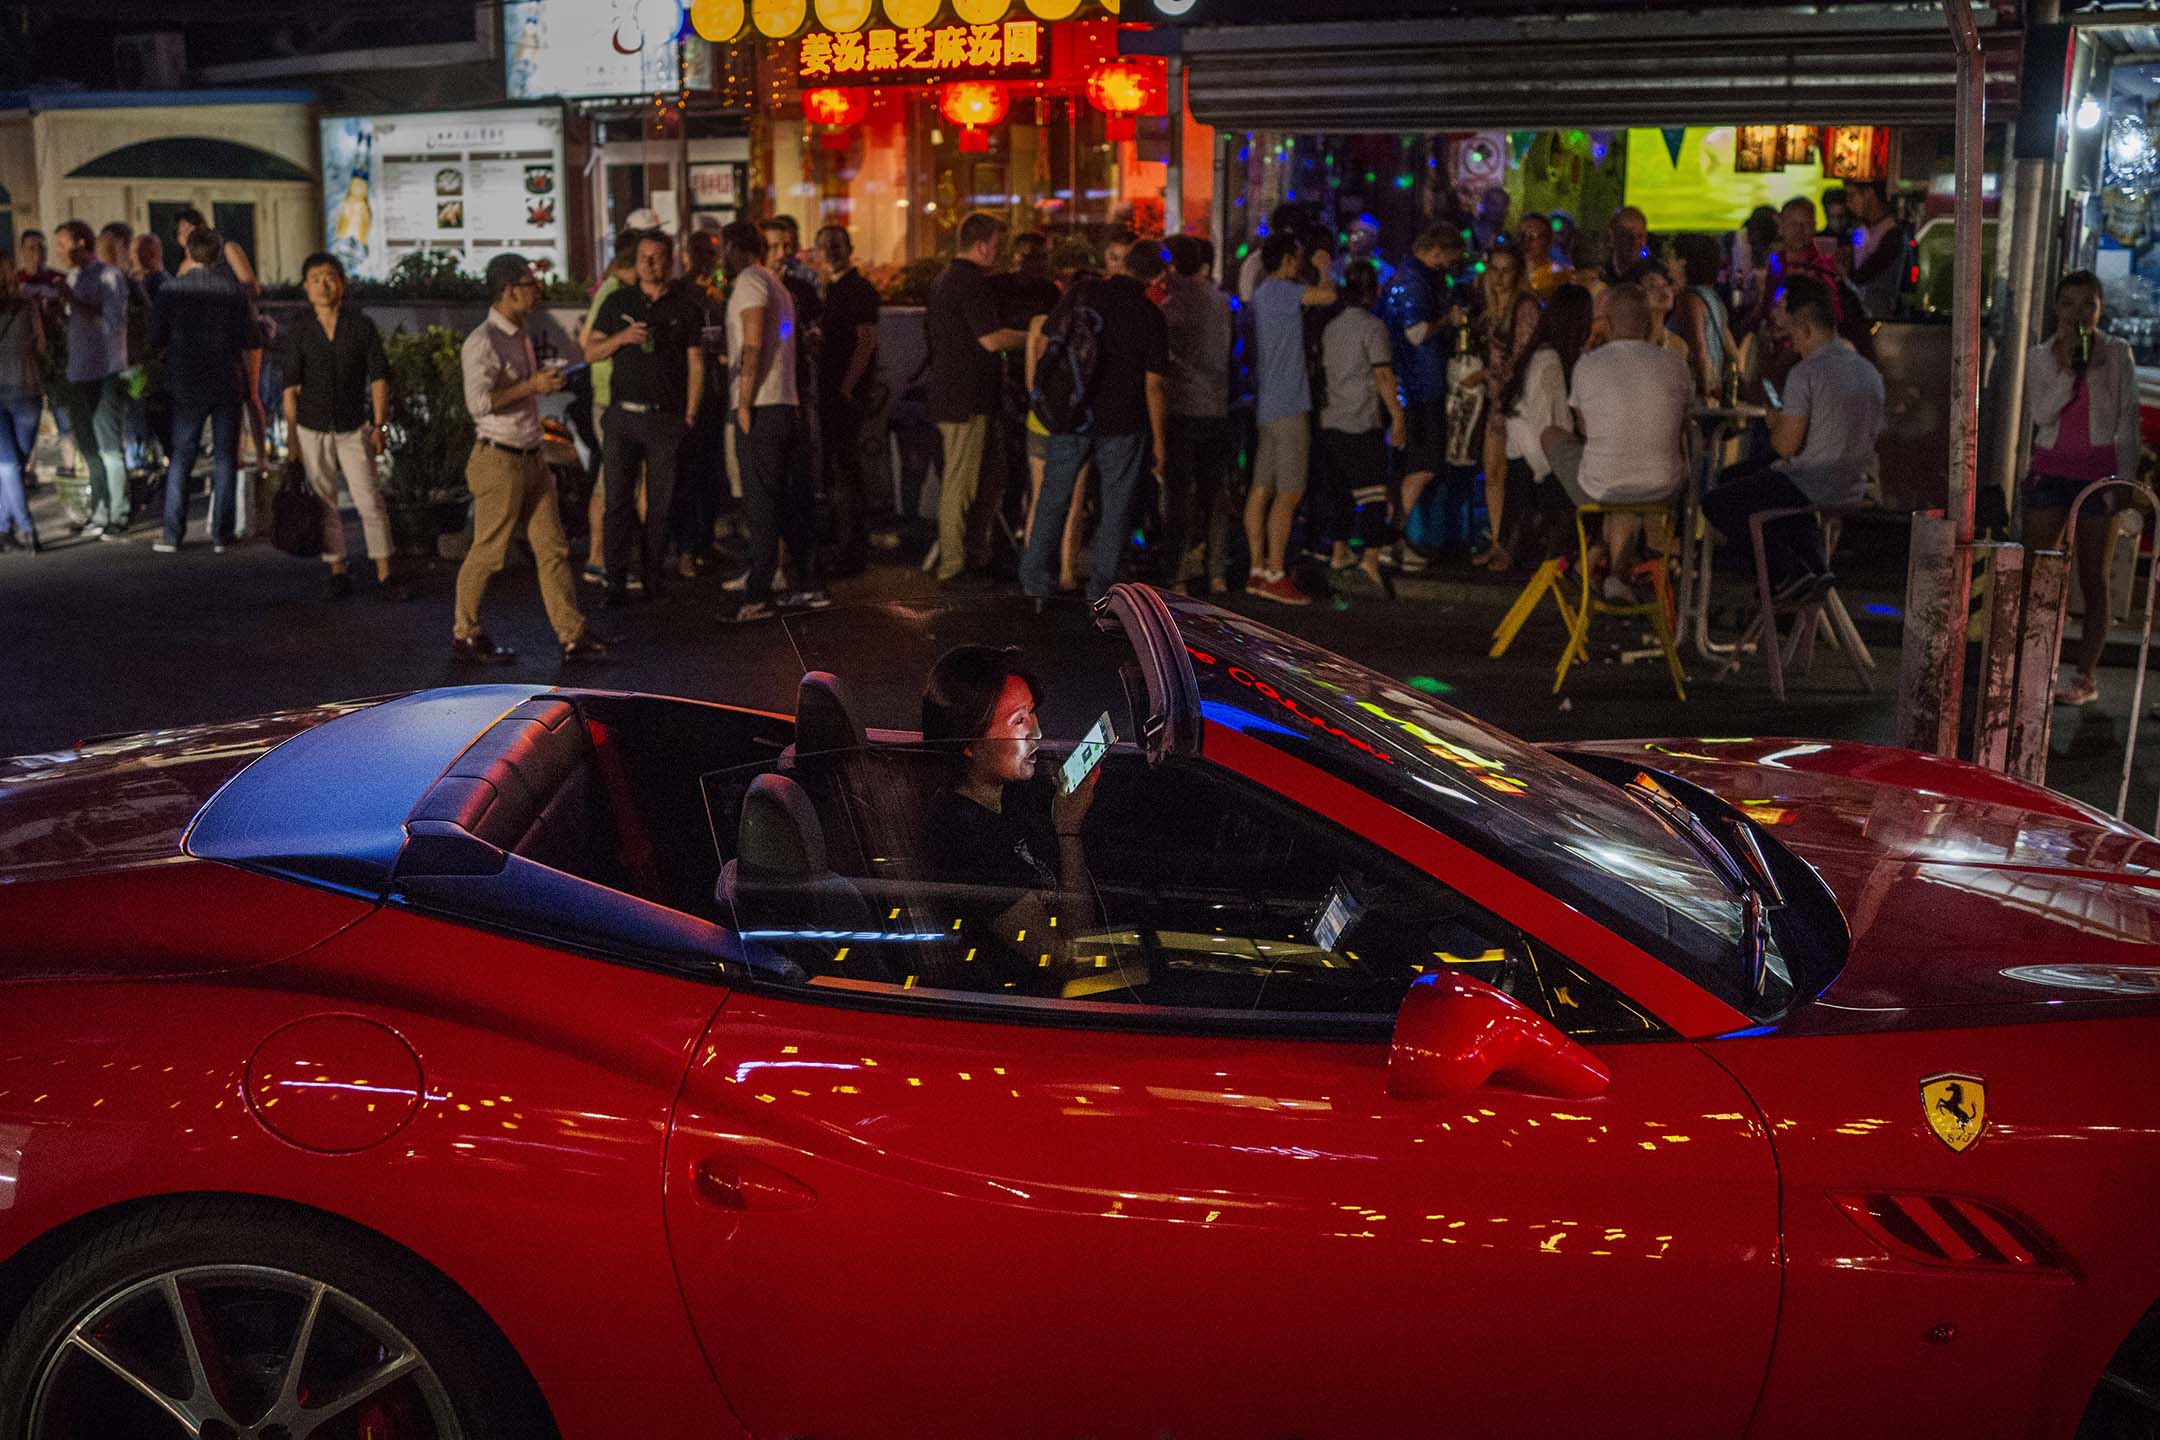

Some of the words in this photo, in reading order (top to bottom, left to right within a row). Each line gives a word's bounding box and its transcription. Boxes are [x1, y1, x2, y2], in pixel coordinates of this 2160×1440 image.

[799, 21, 1037, 75] 姜汤黑芝麻汤圆
